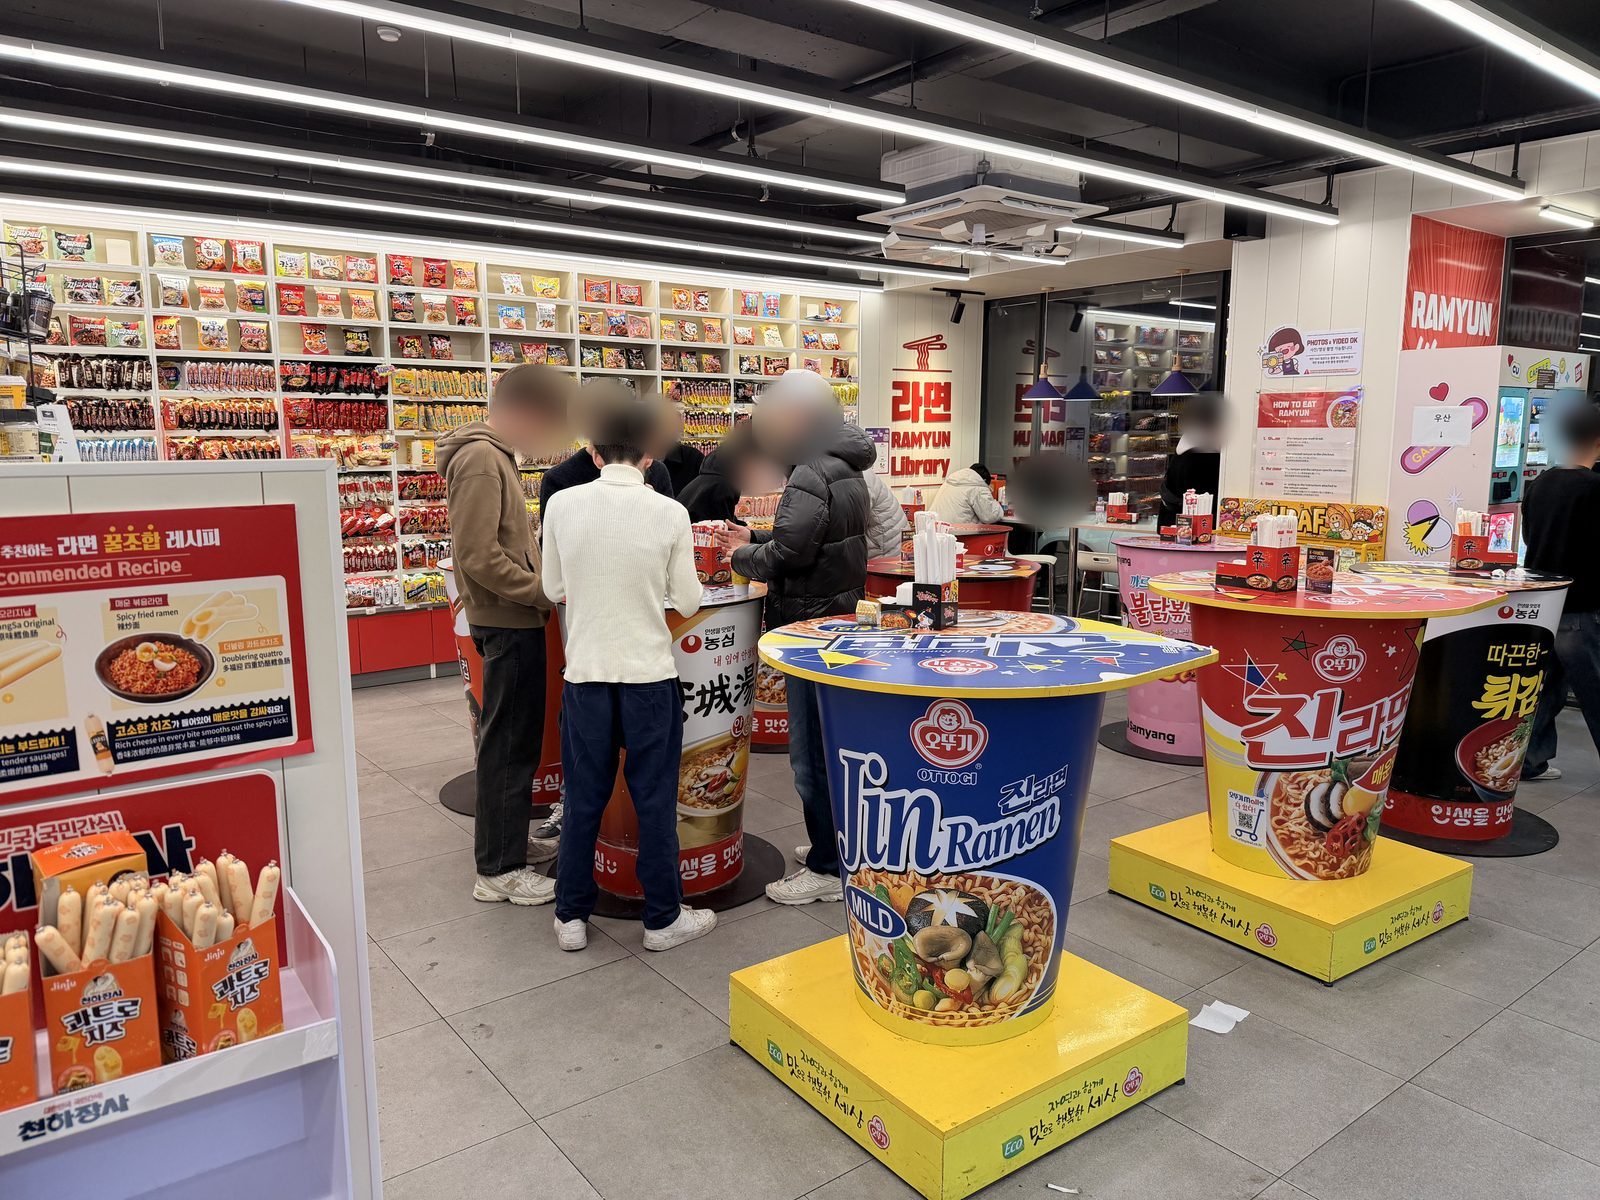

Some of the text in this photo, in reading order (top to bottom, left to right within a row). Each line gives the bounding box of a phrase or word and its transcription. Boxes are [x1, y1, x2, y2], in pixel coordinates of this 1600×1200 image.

[1411, 291, 1492, 337] RAMYUN
[1307, 338, 1328, 346] PHOTOS
[891, 381, 952, 424] 라면
[1273, 401, 1289, 409] HOW
[1302, 400, 1317, 408] EAT
[1279, 409, 1310, 417] RAMYUN
[1434, 413, 1451, 423] 우산
[891, 431, 951, 449] RAMYUN
[891, 456, 951, 478] Library
[1, 528, 221, 559] 추천하는 라면 꿀조합 레시피
[1463, 540, 1476, 557] 辛
[118, 559, 182, 577] Recipe
[1252, 550, 1265, 570] 辛
[1281, 552, 1291, 571] 辛
[23, 618, 55, 629] Original
[116, 609, 178, 621] Spicy fried ramen
[1515, 609, 1539, 620] 농심
[704, 632, 735, 651] 농심
[222, 650, 283, 663] Doublering quattro
[714, 652, 740, 667] 내 입에
[1323, 657, 1356, 672] 오뚜기
[115, 721, 148, 737] 고소한
[151, 718, 180, 733] 치즈가
[213, 708, 248, 722] 매운맛을
[115, 716, 289, 749] Rich cheese in every bite smooths out the spicy kick!
[925, 731, 973, 752] 오뚜기
[1128, 722, 1175, 745] Samyang
[1, 750, 67, 767] tender sausages!
[916, 769, 978, 786] OTTOGI
[997, 763, 1069, 816] 진라면
[838, 748, 942, 877] Jin
[1431, 804, 1489, 827] 인생을
[943, 796, 1061, 874] Ramen
[1185, 886, 1215, 904] 자연과
[848, 898, 895, 934] MILD
[1170, 890, 1251, 937] 맛으로 행복한 세상
[1411, 911, 1430, 931] 세상
[204, 948, 225, 962] Jinju
[50, 979, 77, 993] Jinju
[211, 959, 270, 1001] 콰트로
[228, 980, 260, 1011] 치즈
[61, 998, 141, 1034] 콰트로
[85, 1020, 126, 1047] 치즈
[800, 1050, 828, 1079] 자연과
[787, 1053, 864, 1129] 맛으로 행복한 세상
[1048, 1089, 1082, 1114] 자연과
[18, 1094, 130, 1142] 천하장사
[1029, 1083, 1119, 1146] 맛으로 행복한 세상
